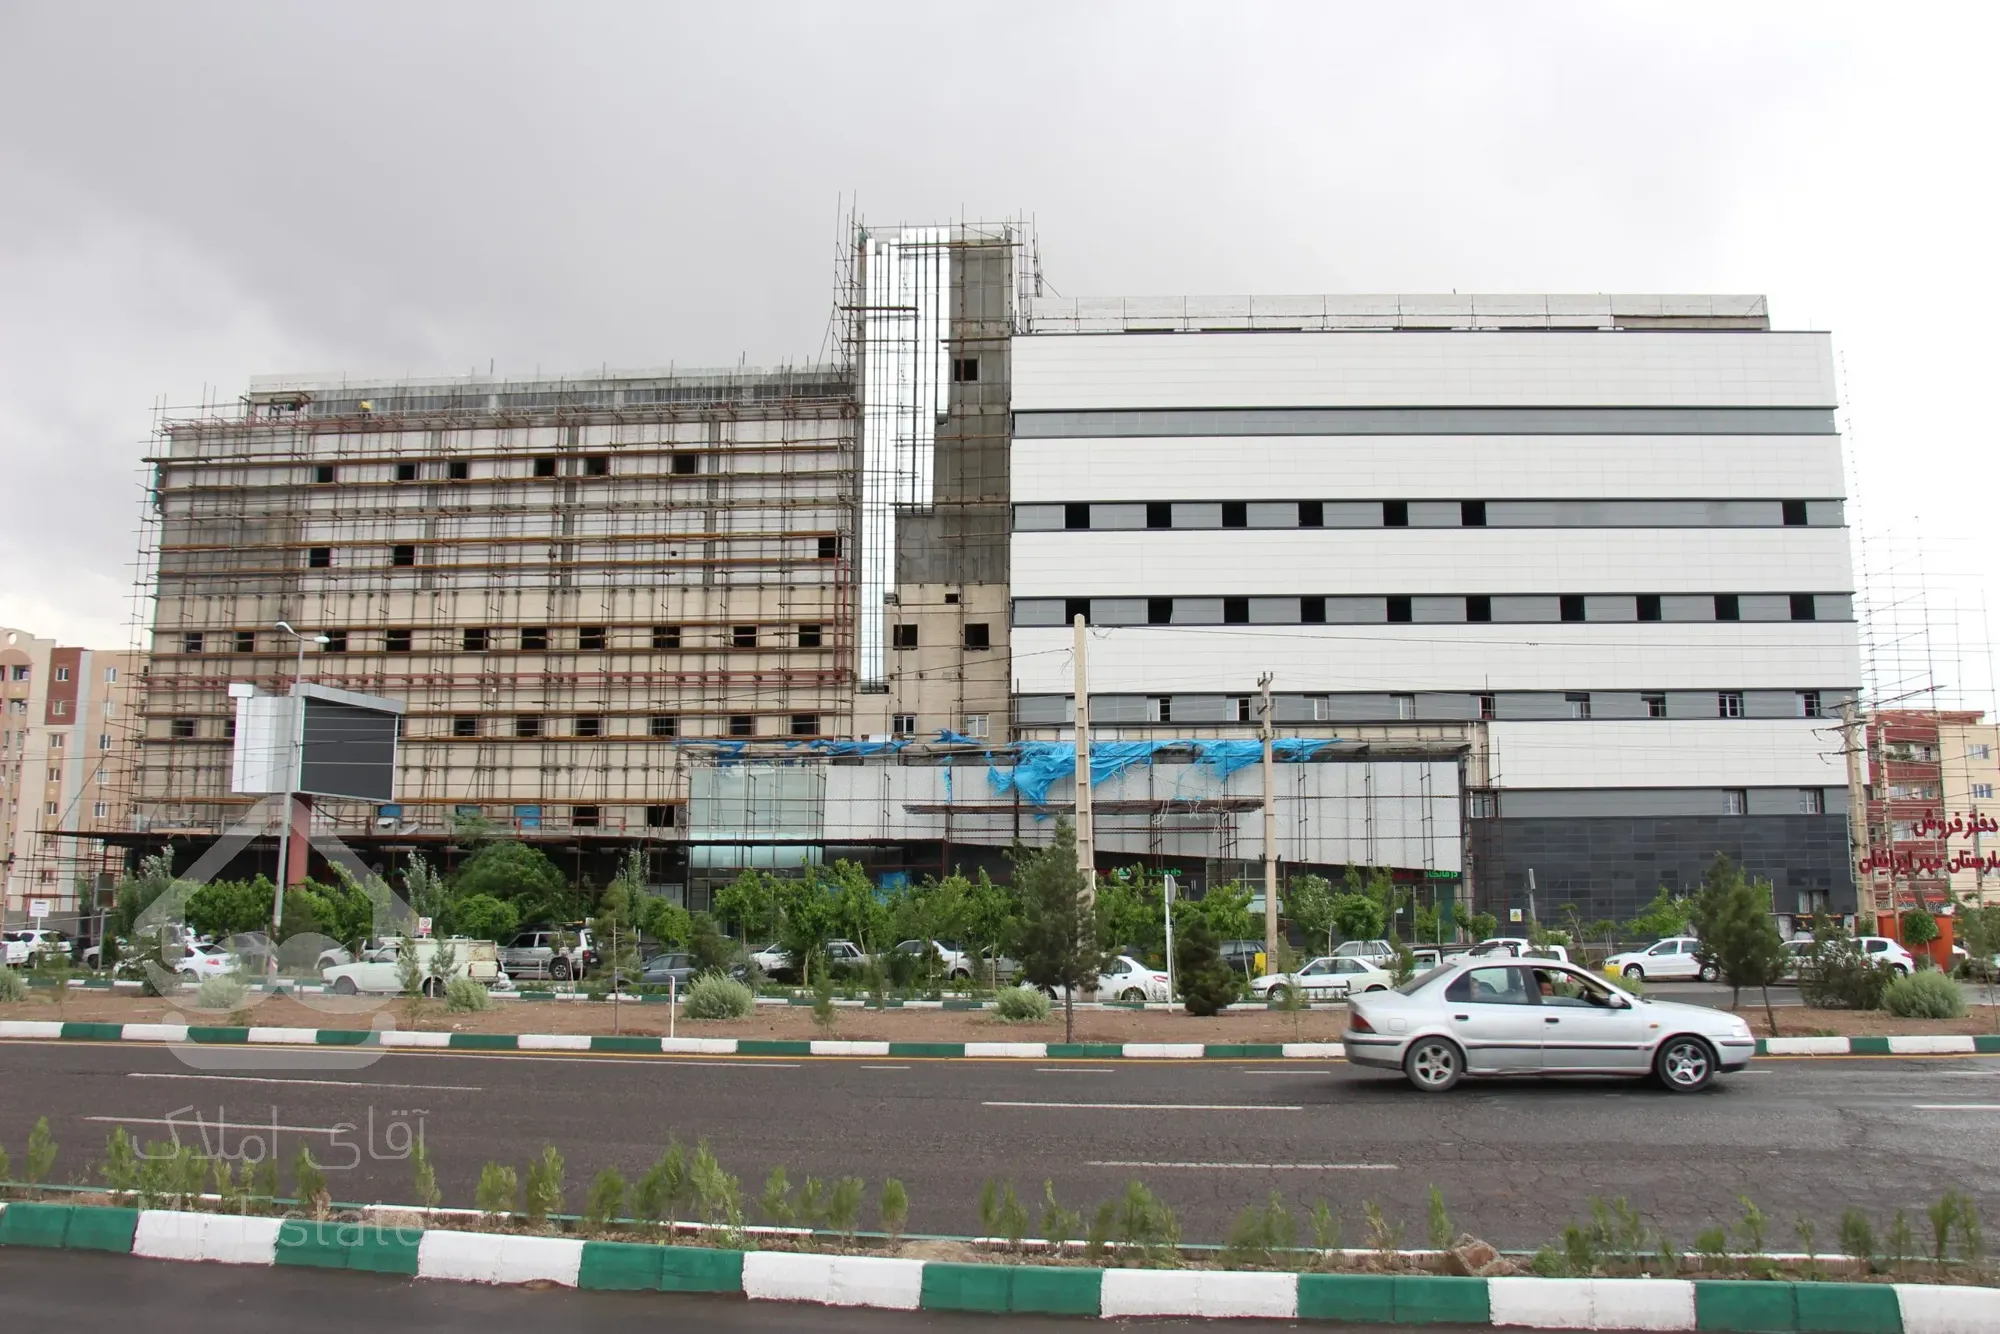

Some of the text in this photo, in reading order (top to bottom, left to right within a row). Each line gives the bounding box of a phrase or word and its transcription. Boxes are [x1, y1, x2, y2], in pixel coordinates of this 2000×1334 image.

[1913, 808, 1999, 839] دفتر فروش
[1947, 850, 2000, 875] ارستان
